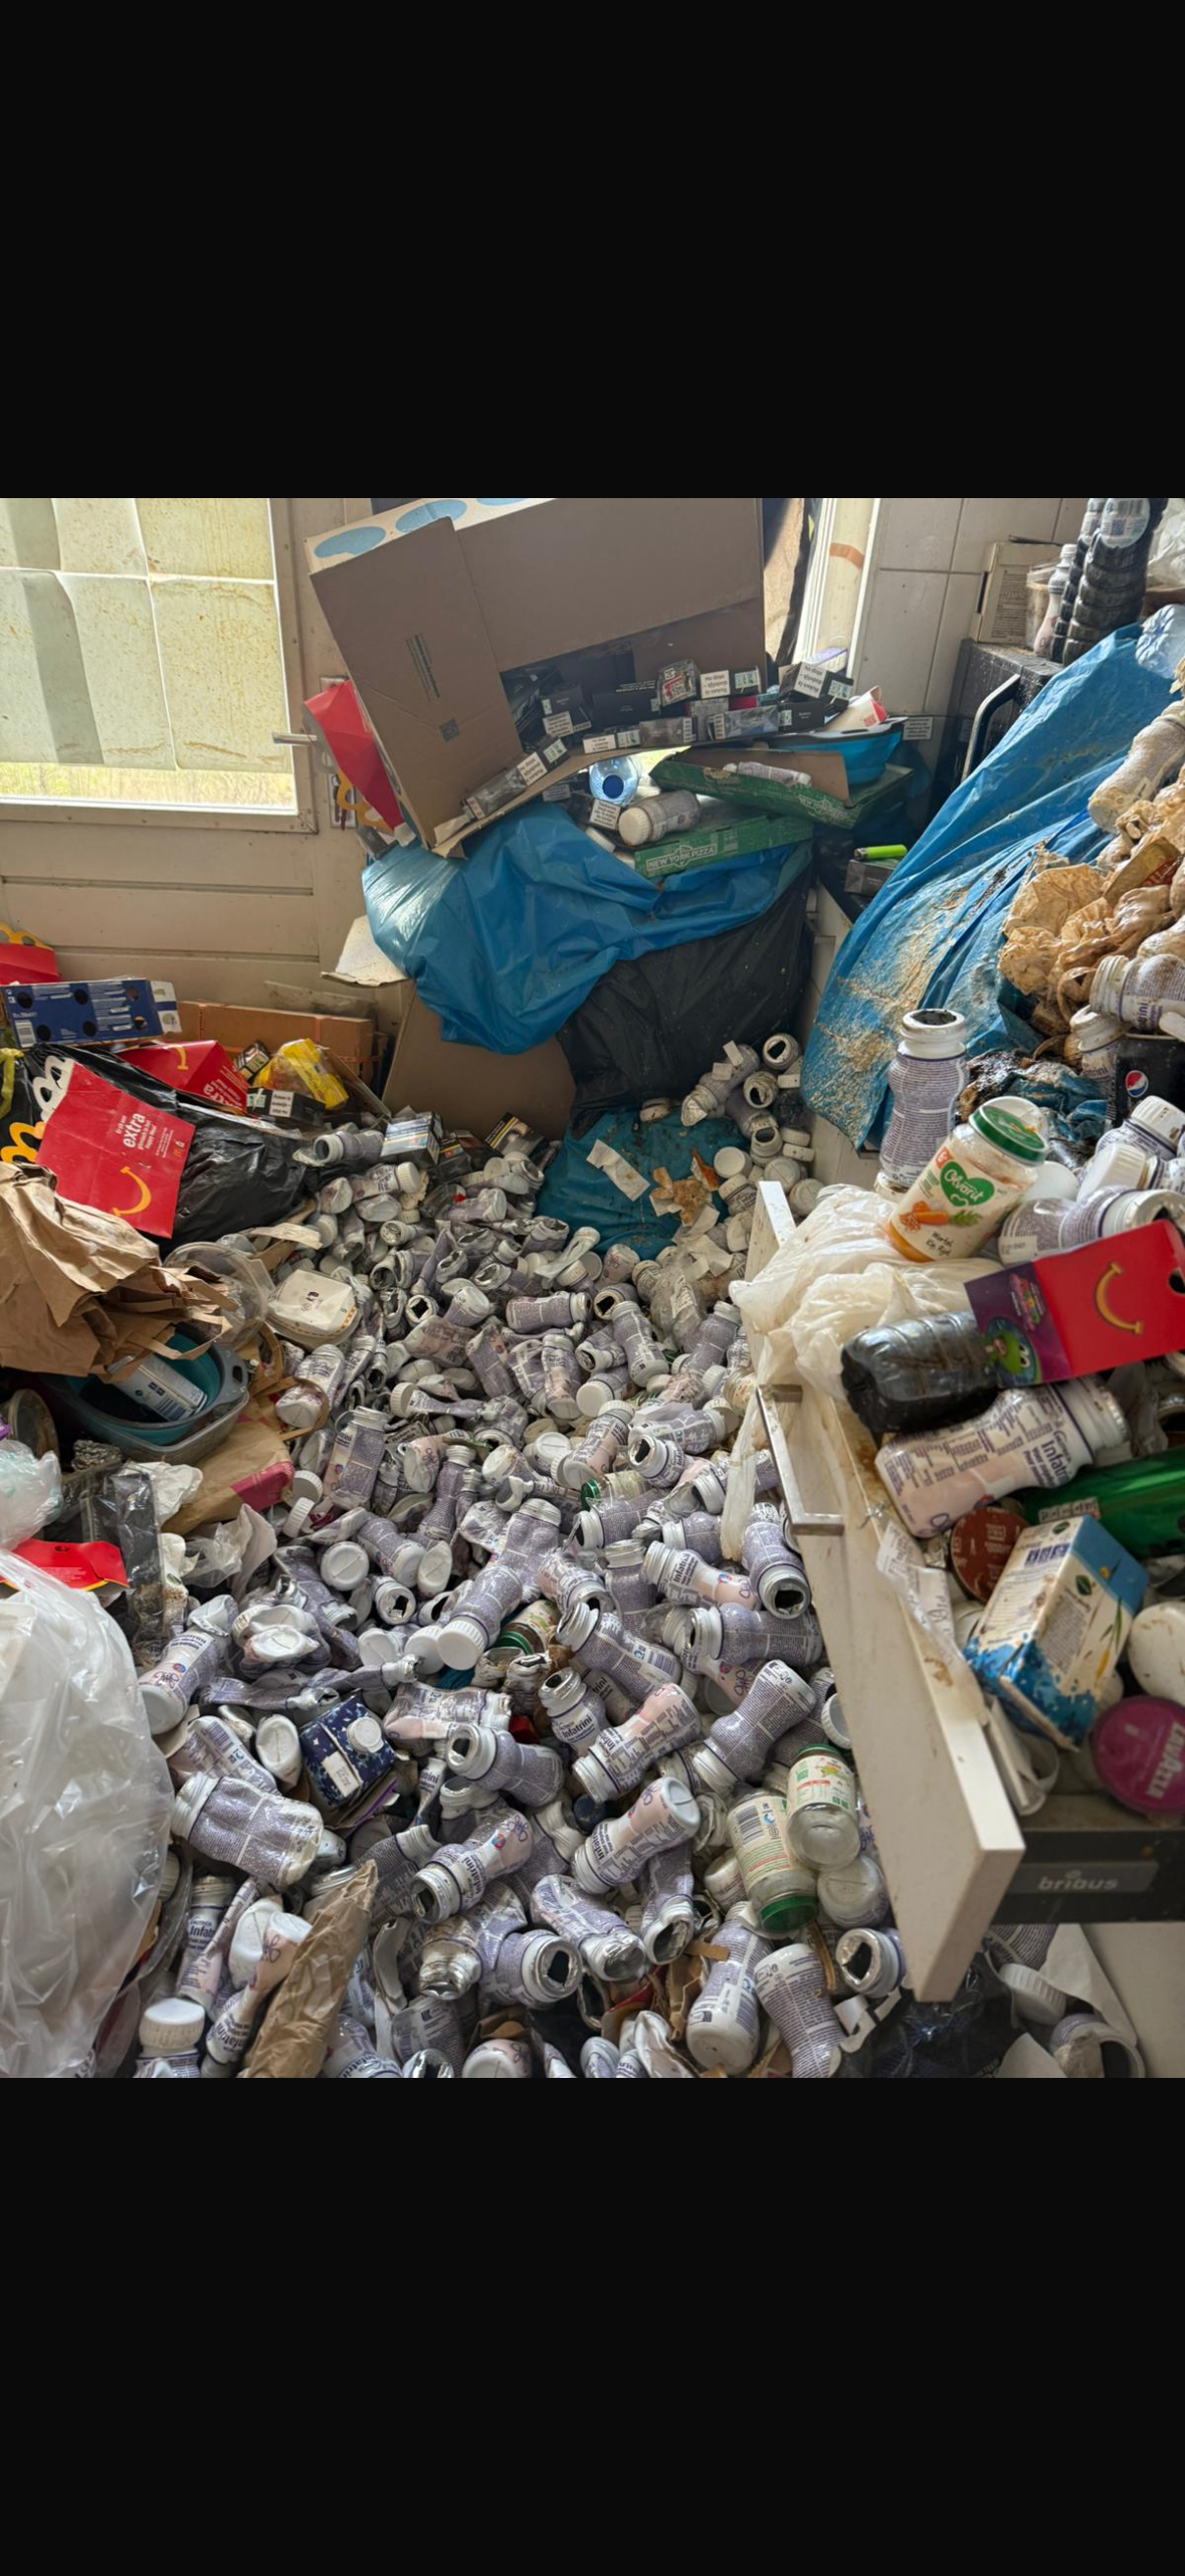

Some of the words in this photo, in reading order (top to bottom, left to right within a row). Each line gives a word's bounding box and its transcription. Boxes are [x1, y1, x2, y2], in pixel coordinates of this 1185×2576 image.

[648, 857, 665, 869] NEW
[666, 851, 690, 866] YORK
[689, 846, 716, 860] PIZZA
[122, 1113, 146, 1148] extra
[944, 1168, 985, 1203] Olvarit
[1040, 1438, 1072, 1483] Infatri
[562, 1713, 592, 1737] Infatrini
[1145, 1721, 1185, 1799] LAVAZZA
[462, 1857, 482, 1895] Infatrini
[1039, 1874, 1117, 1891] bribus
